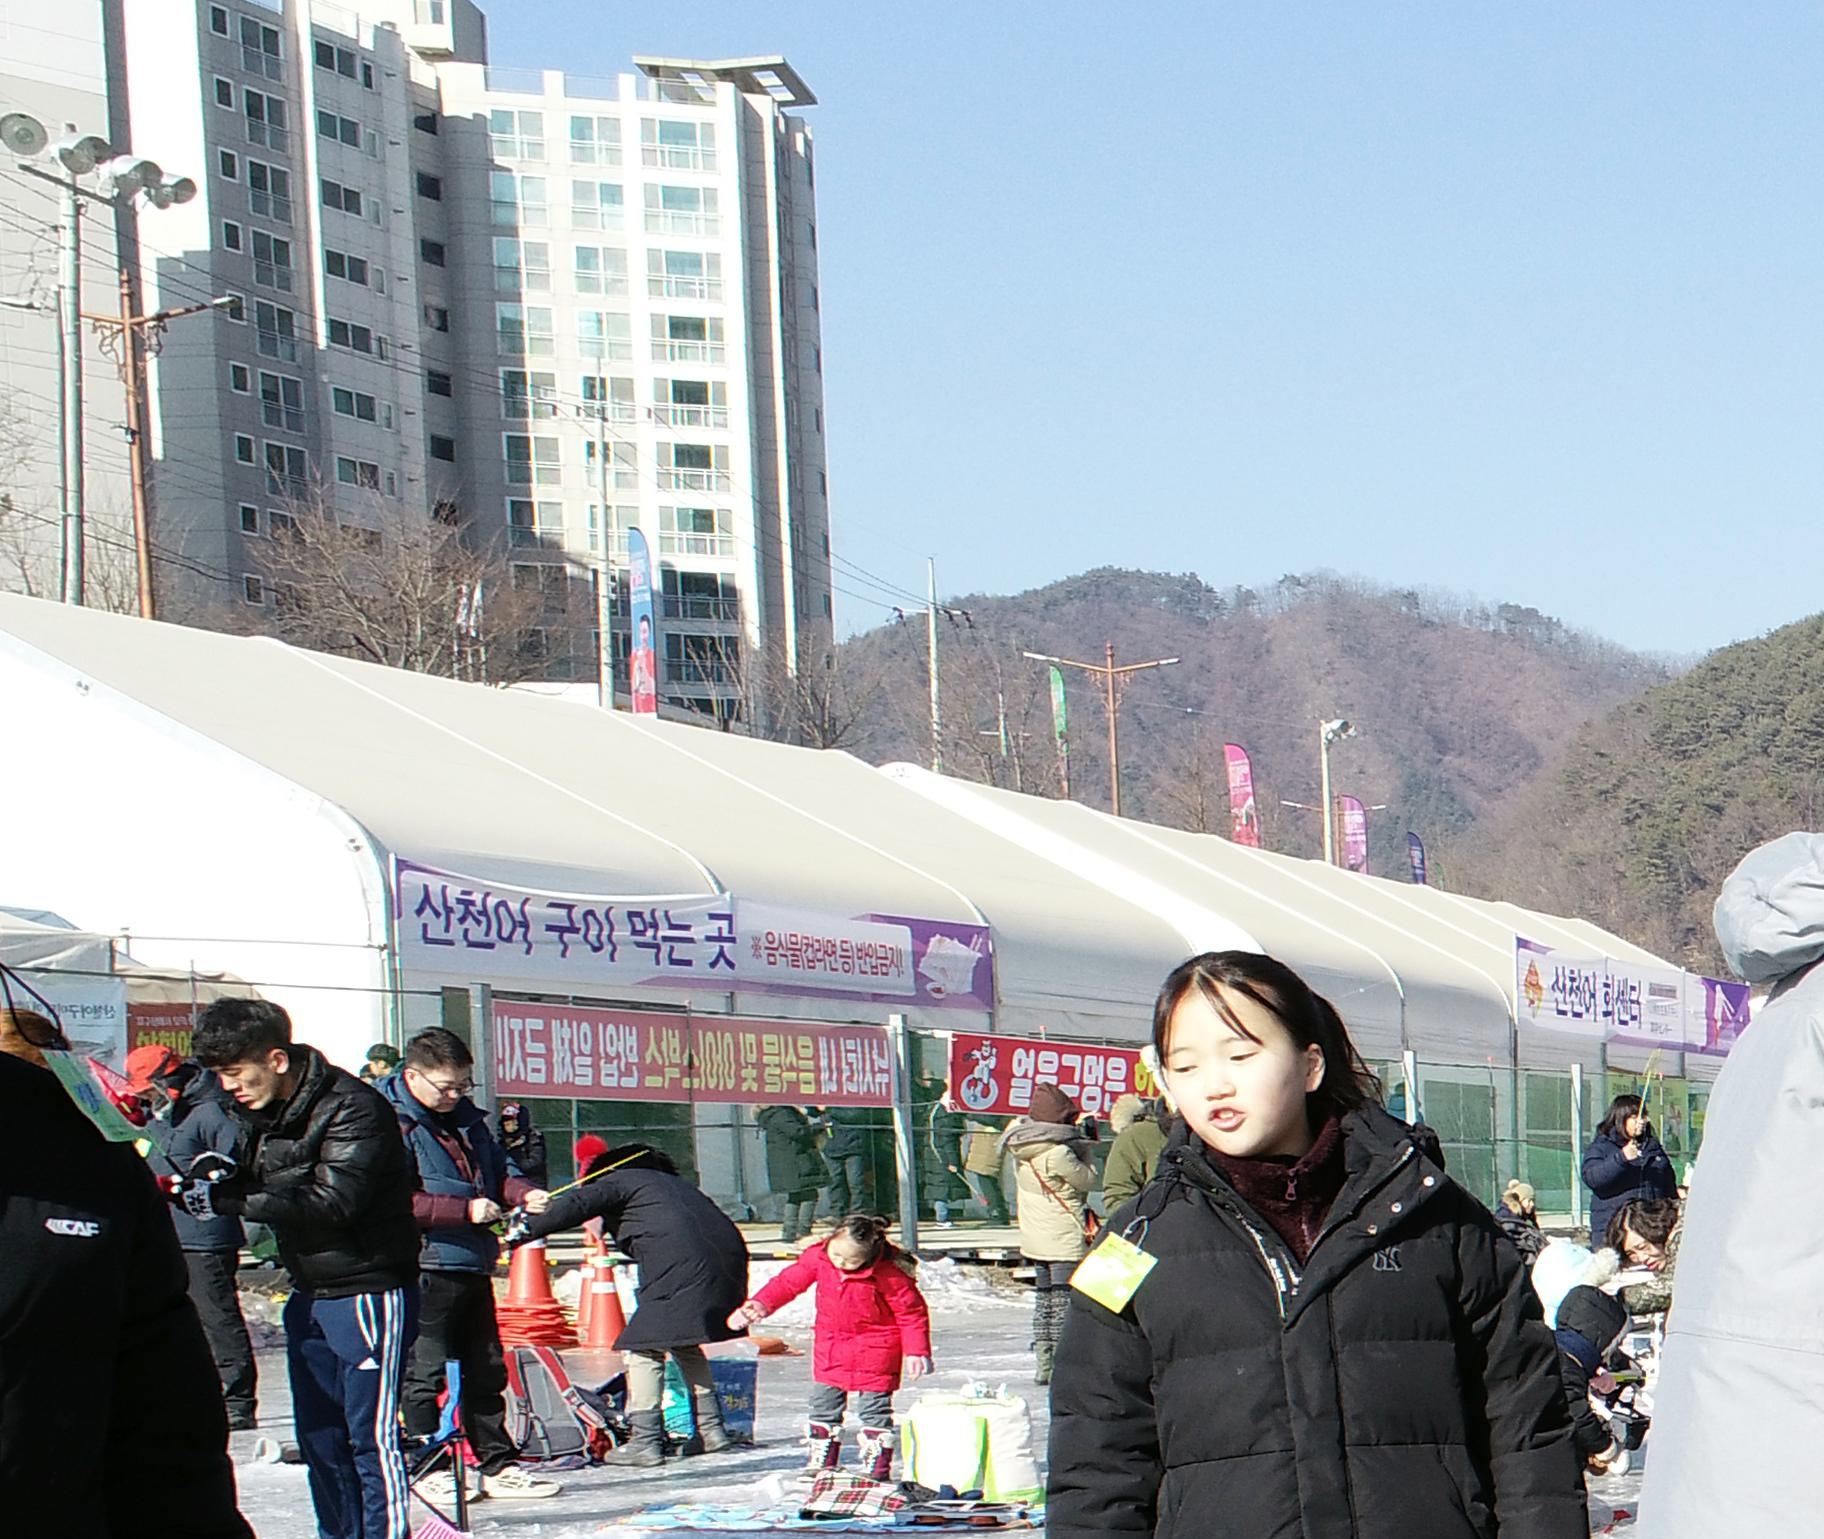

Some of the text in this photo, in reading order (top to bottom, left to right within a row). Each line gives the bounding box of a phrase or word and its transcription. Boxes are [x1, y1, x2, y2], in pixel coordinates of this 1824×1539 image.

[414, 883, 738, 970] 산천어 구이 먹는 곳
[856, 941, 906, 978] 반입금지!
[1551, 965, 1643, 1030] 산천어 회센터
